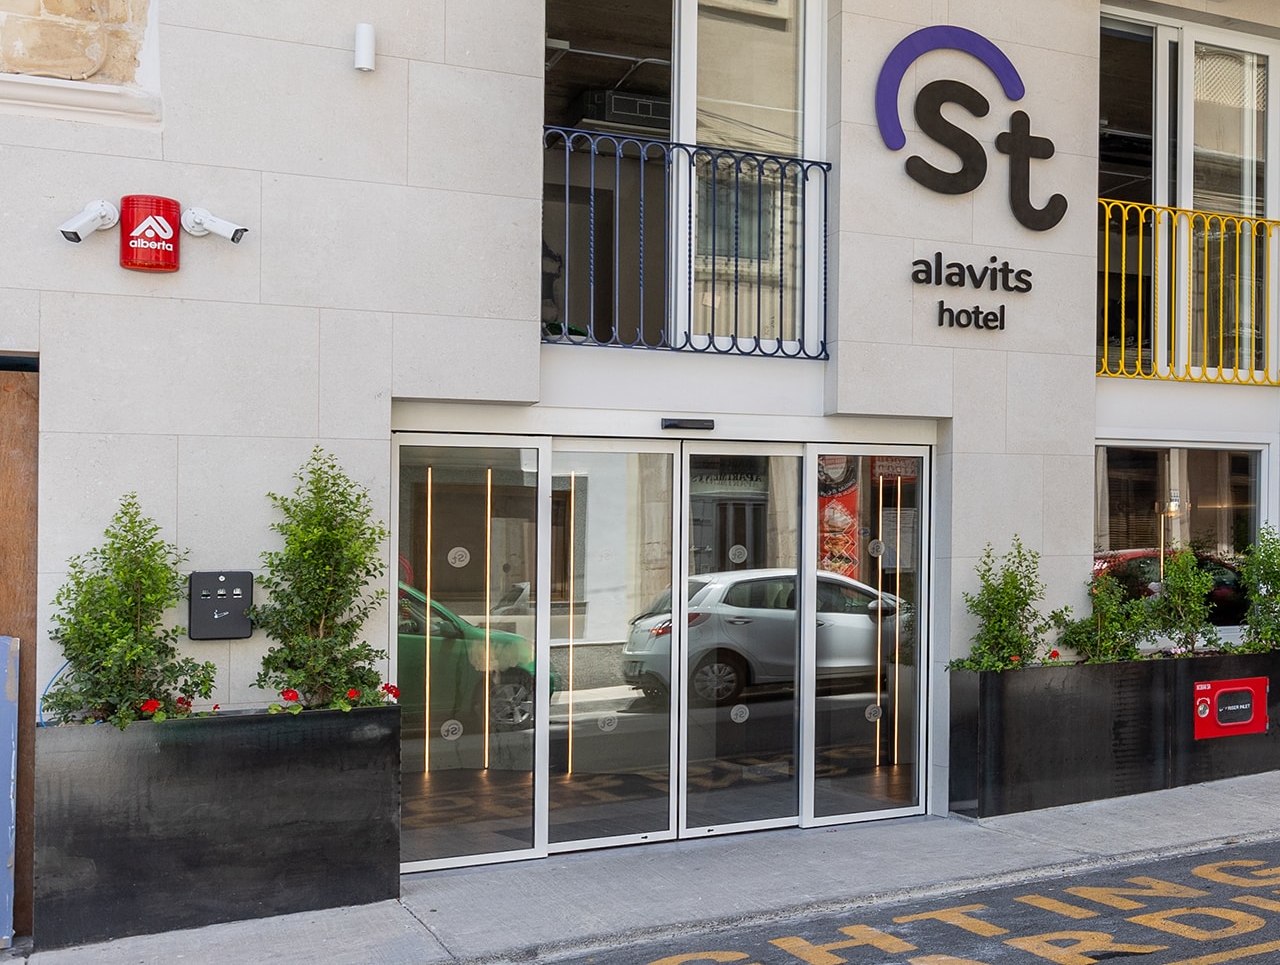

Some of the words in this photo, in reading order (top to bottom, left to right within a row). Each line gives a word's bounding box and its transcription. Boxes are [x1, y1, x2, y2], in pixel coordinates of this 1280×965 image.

[129, 238, 173, 251] alberta
[911, 252, 1033, 293] alavits
[938, 300, 1006, 331] hotel
